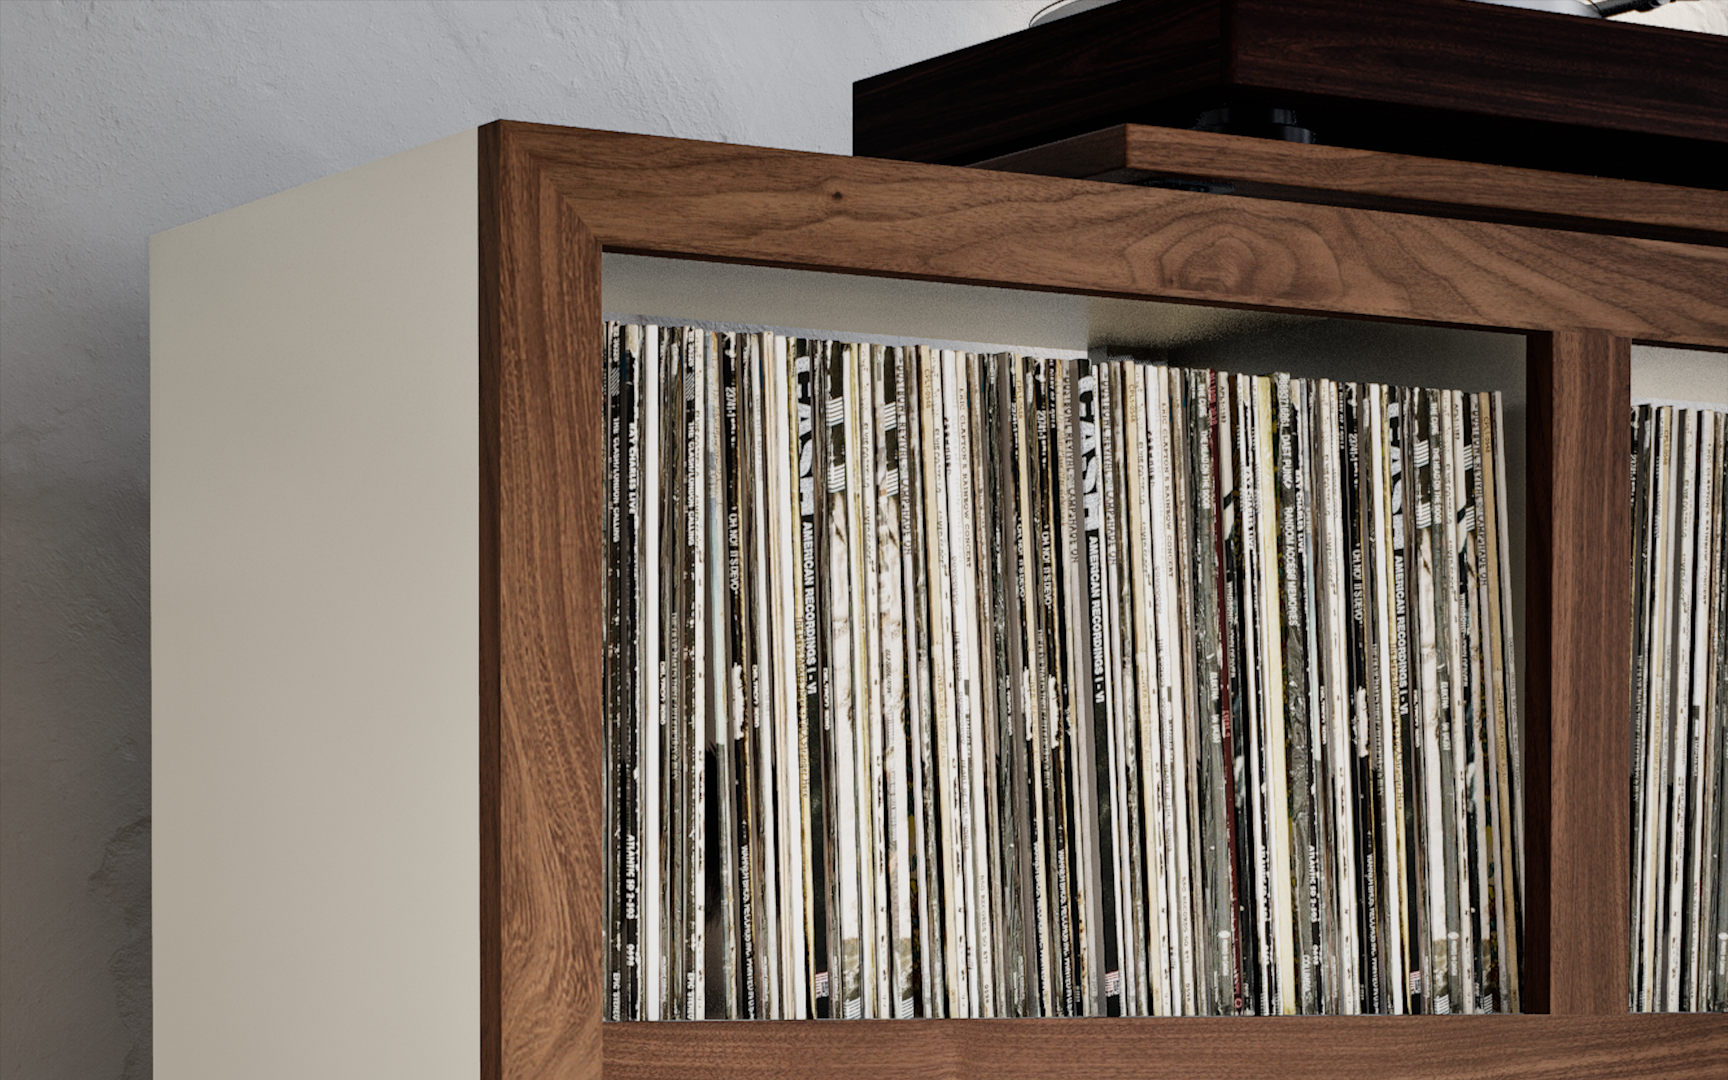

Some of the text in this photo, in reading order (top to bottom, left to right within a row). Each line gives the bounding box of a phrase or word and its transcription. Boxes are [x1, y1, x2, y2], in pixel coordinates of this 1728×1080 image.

[1197, 384, 1207, 397] THE
[1198, 398, 1207, 417] CURE
[796, 356, 814, 516] CASH
[1078, 375, 1099, 531] CASH
[1200, 430, 1209, 442] THE
[1201, 445, 1209, 462] HEAD
[628, 422, 636, 514] RAY CHARLES LIVE
[1202, 475, 1210, 488] THE
[1388, 402, 1404, 550] CASH
[1202, 490, 1211, 509] DOOR
[612, 507, 620, 542] CALLING
[1285, 507, 1295, 543] RANDOM
[803, 522, 815, 585] AMERICAN
[1089, 536, 1100, 597] AMERICAN
[1286, 546, 1296, 580] ACCESS
[1288, 582, 1298, 626] MEMORIES
[1394, 556, 1406, 614] AMERICAN
[805, 588, 816, 664] RECORDINGS
[1092, 600, 1103, 675] RECORDINGS
[1397, 616, 1407, 688] RECORDINGS
[807, 682, 817, 694] VI
[1095, 691, 1105, 703] VI
[1399, 704, 1408, 715] VI
[626, 835, 635, 877] ATLANTIC
